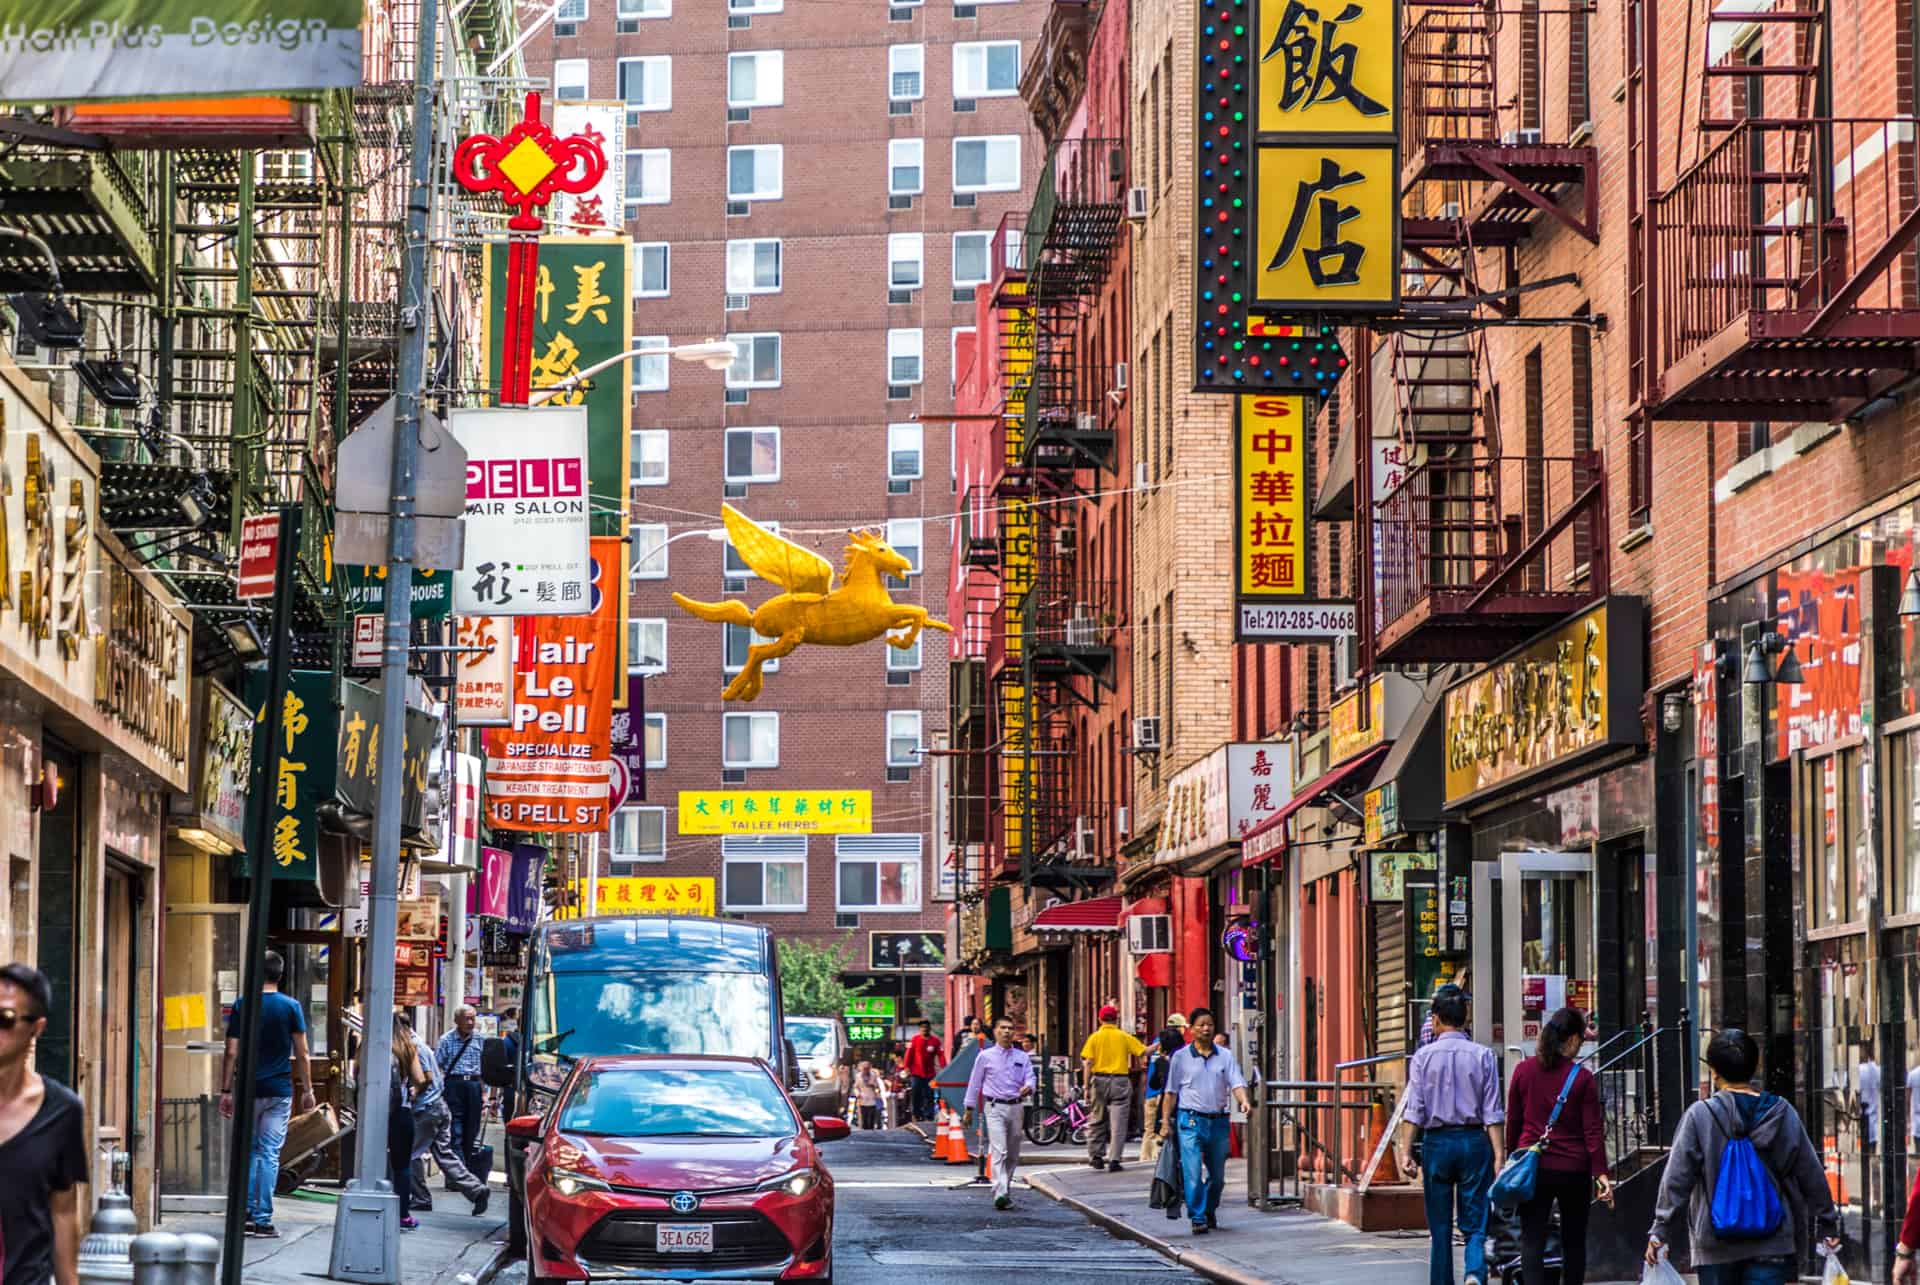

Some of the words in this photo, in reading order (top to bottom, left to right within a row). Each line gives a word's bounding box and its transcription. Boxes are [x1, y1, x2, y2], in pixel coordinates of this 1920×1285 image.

[190, 14, 328, 50] Design
[1261, 1, 1390, 287] 飯店
[466, 463, 577, 495] PELL
[465, 502, 505, 515] AIR
[514, 501, 583, 515] SALON
[1250, 430, 1295, 588] 中華拉麵
[244, 543, 271, 563] Anytime
[410, 583, 445, 600] HOUSE
[1243, 610, 1355, 630] Tel:212-285-0668
[525, 670, 575, 698] Le
[514, 704, 587, 733] Pell
[506, 743, 592, 758] SPECIALIZE
[496, 761, 538, 772] JAPANESE
[539, 761, 602, 774] STRAIGHTENING
[505, 783, 540, 794] KERATIN
[542, 784, 591, 795] TREATMENT
[492, 803, 513, 821] 18
[518, 804, 571, 824] PELL
[576, 806, 603, 824] ST
[731, 820, 749, 830] TAI
[752, 820, 774, 830] LEE
[778, 820, 818, 831] HERBS
[687, 1231, 710, 1246] 652
